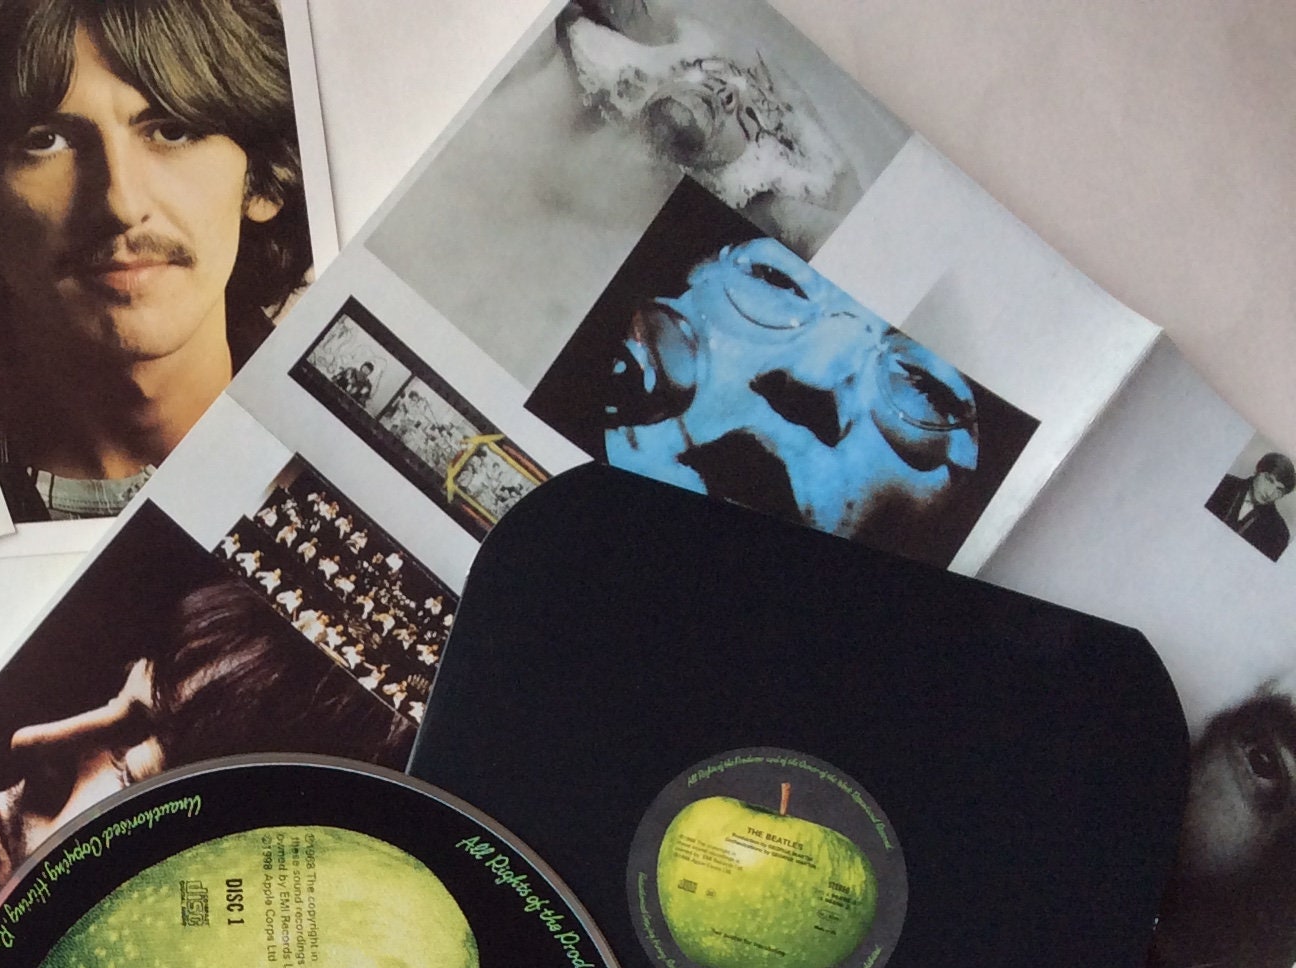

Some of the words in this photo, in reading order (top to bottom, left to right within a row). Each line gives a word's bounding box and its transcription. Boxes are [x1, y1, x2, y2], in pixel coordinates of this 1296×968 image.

[102, 795, 202, 848] Unauthorised
[747, 826, 764, 838] THE
[765, 831, 804, 851] BEATLES
[225, 878, 244, 912] DISC
[262, 874, 274, 906] Apple
[277, 874, 289, 887] by
[293, 871, 303, 901] sound
[308, 873, 317, 893] The
[455, 836, 495, 860] All
[485, 853, 532, 897] Rights
[524, 894, 550, 913] of
[539, 908, 564, 932] the
[280, 891, 291, 911] EMI
[265, 908, 276, 942] Corps
[294, 908, 306, 965] recordings
[306, 896, 319, 945] copyright
[281, 915, 292, 959] Records
[267, 945, 277, 962] Ltd
[310, 948, 319, 961] in
